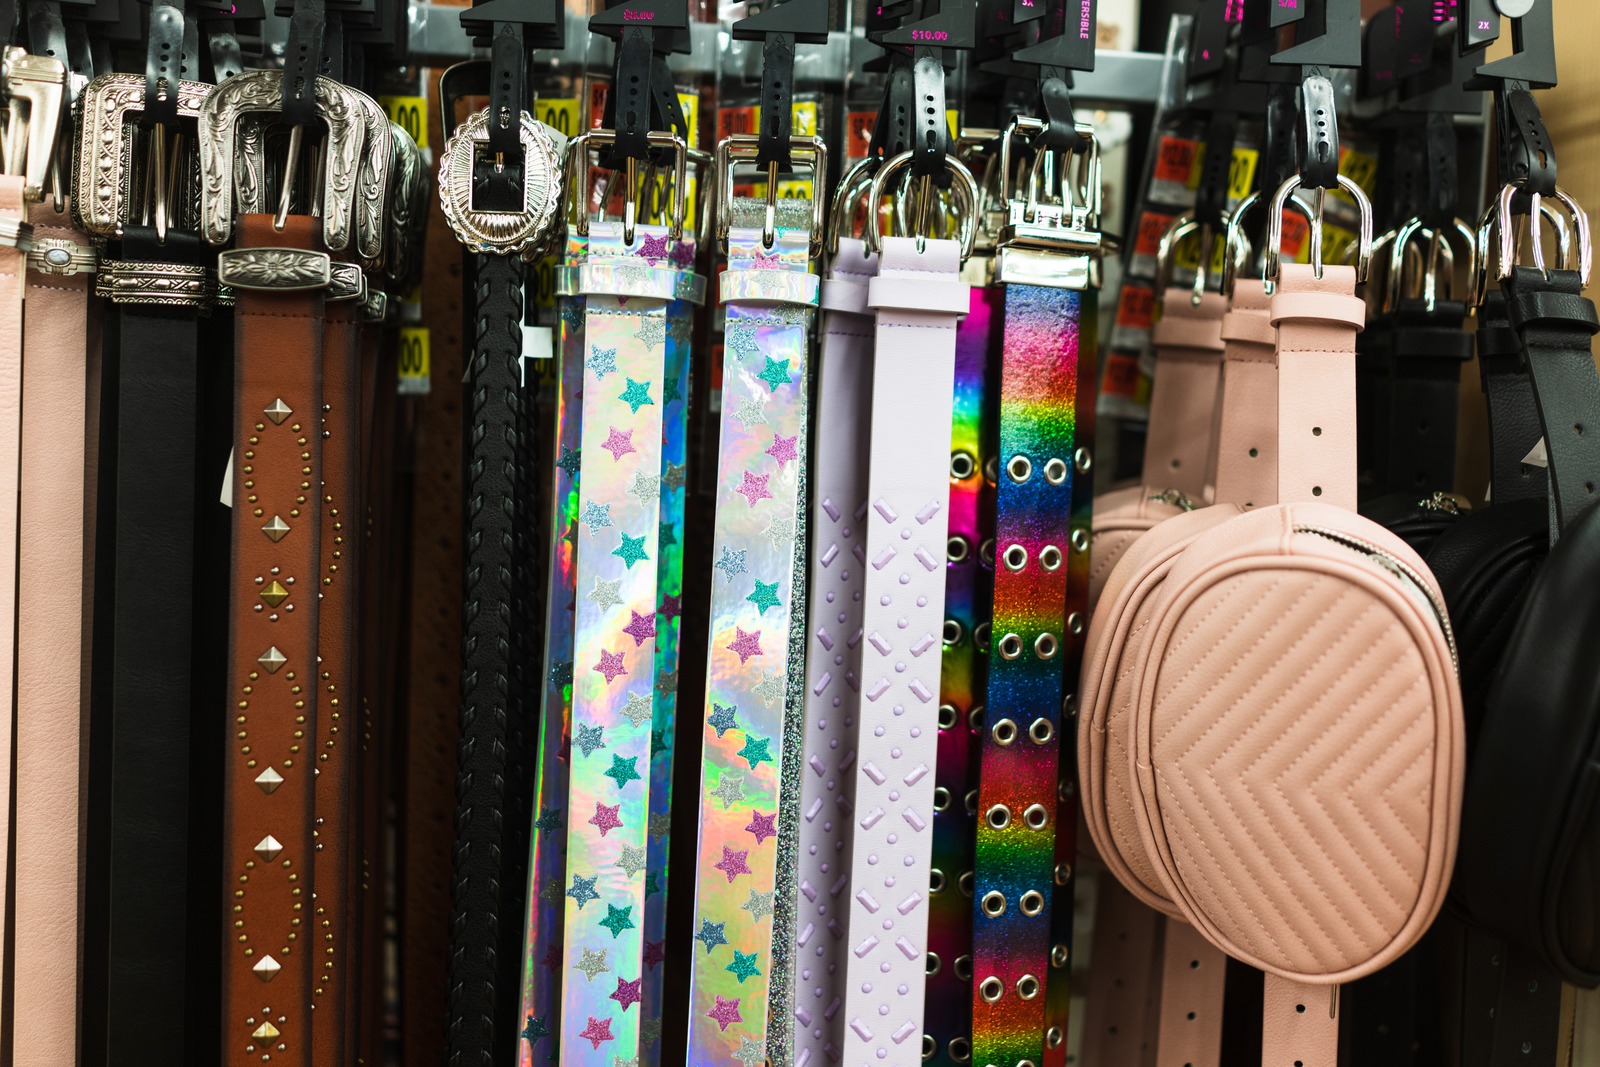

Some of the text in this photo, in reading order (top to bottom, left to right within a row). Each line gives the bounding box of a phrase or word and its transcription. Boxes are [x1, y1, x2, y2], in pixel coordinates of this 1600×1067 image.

[1080, 0, 1090, 39] ERSIBLE
[1478, 21, 1490, 30] 2X
[912, 29, 948, 40] $10.00
